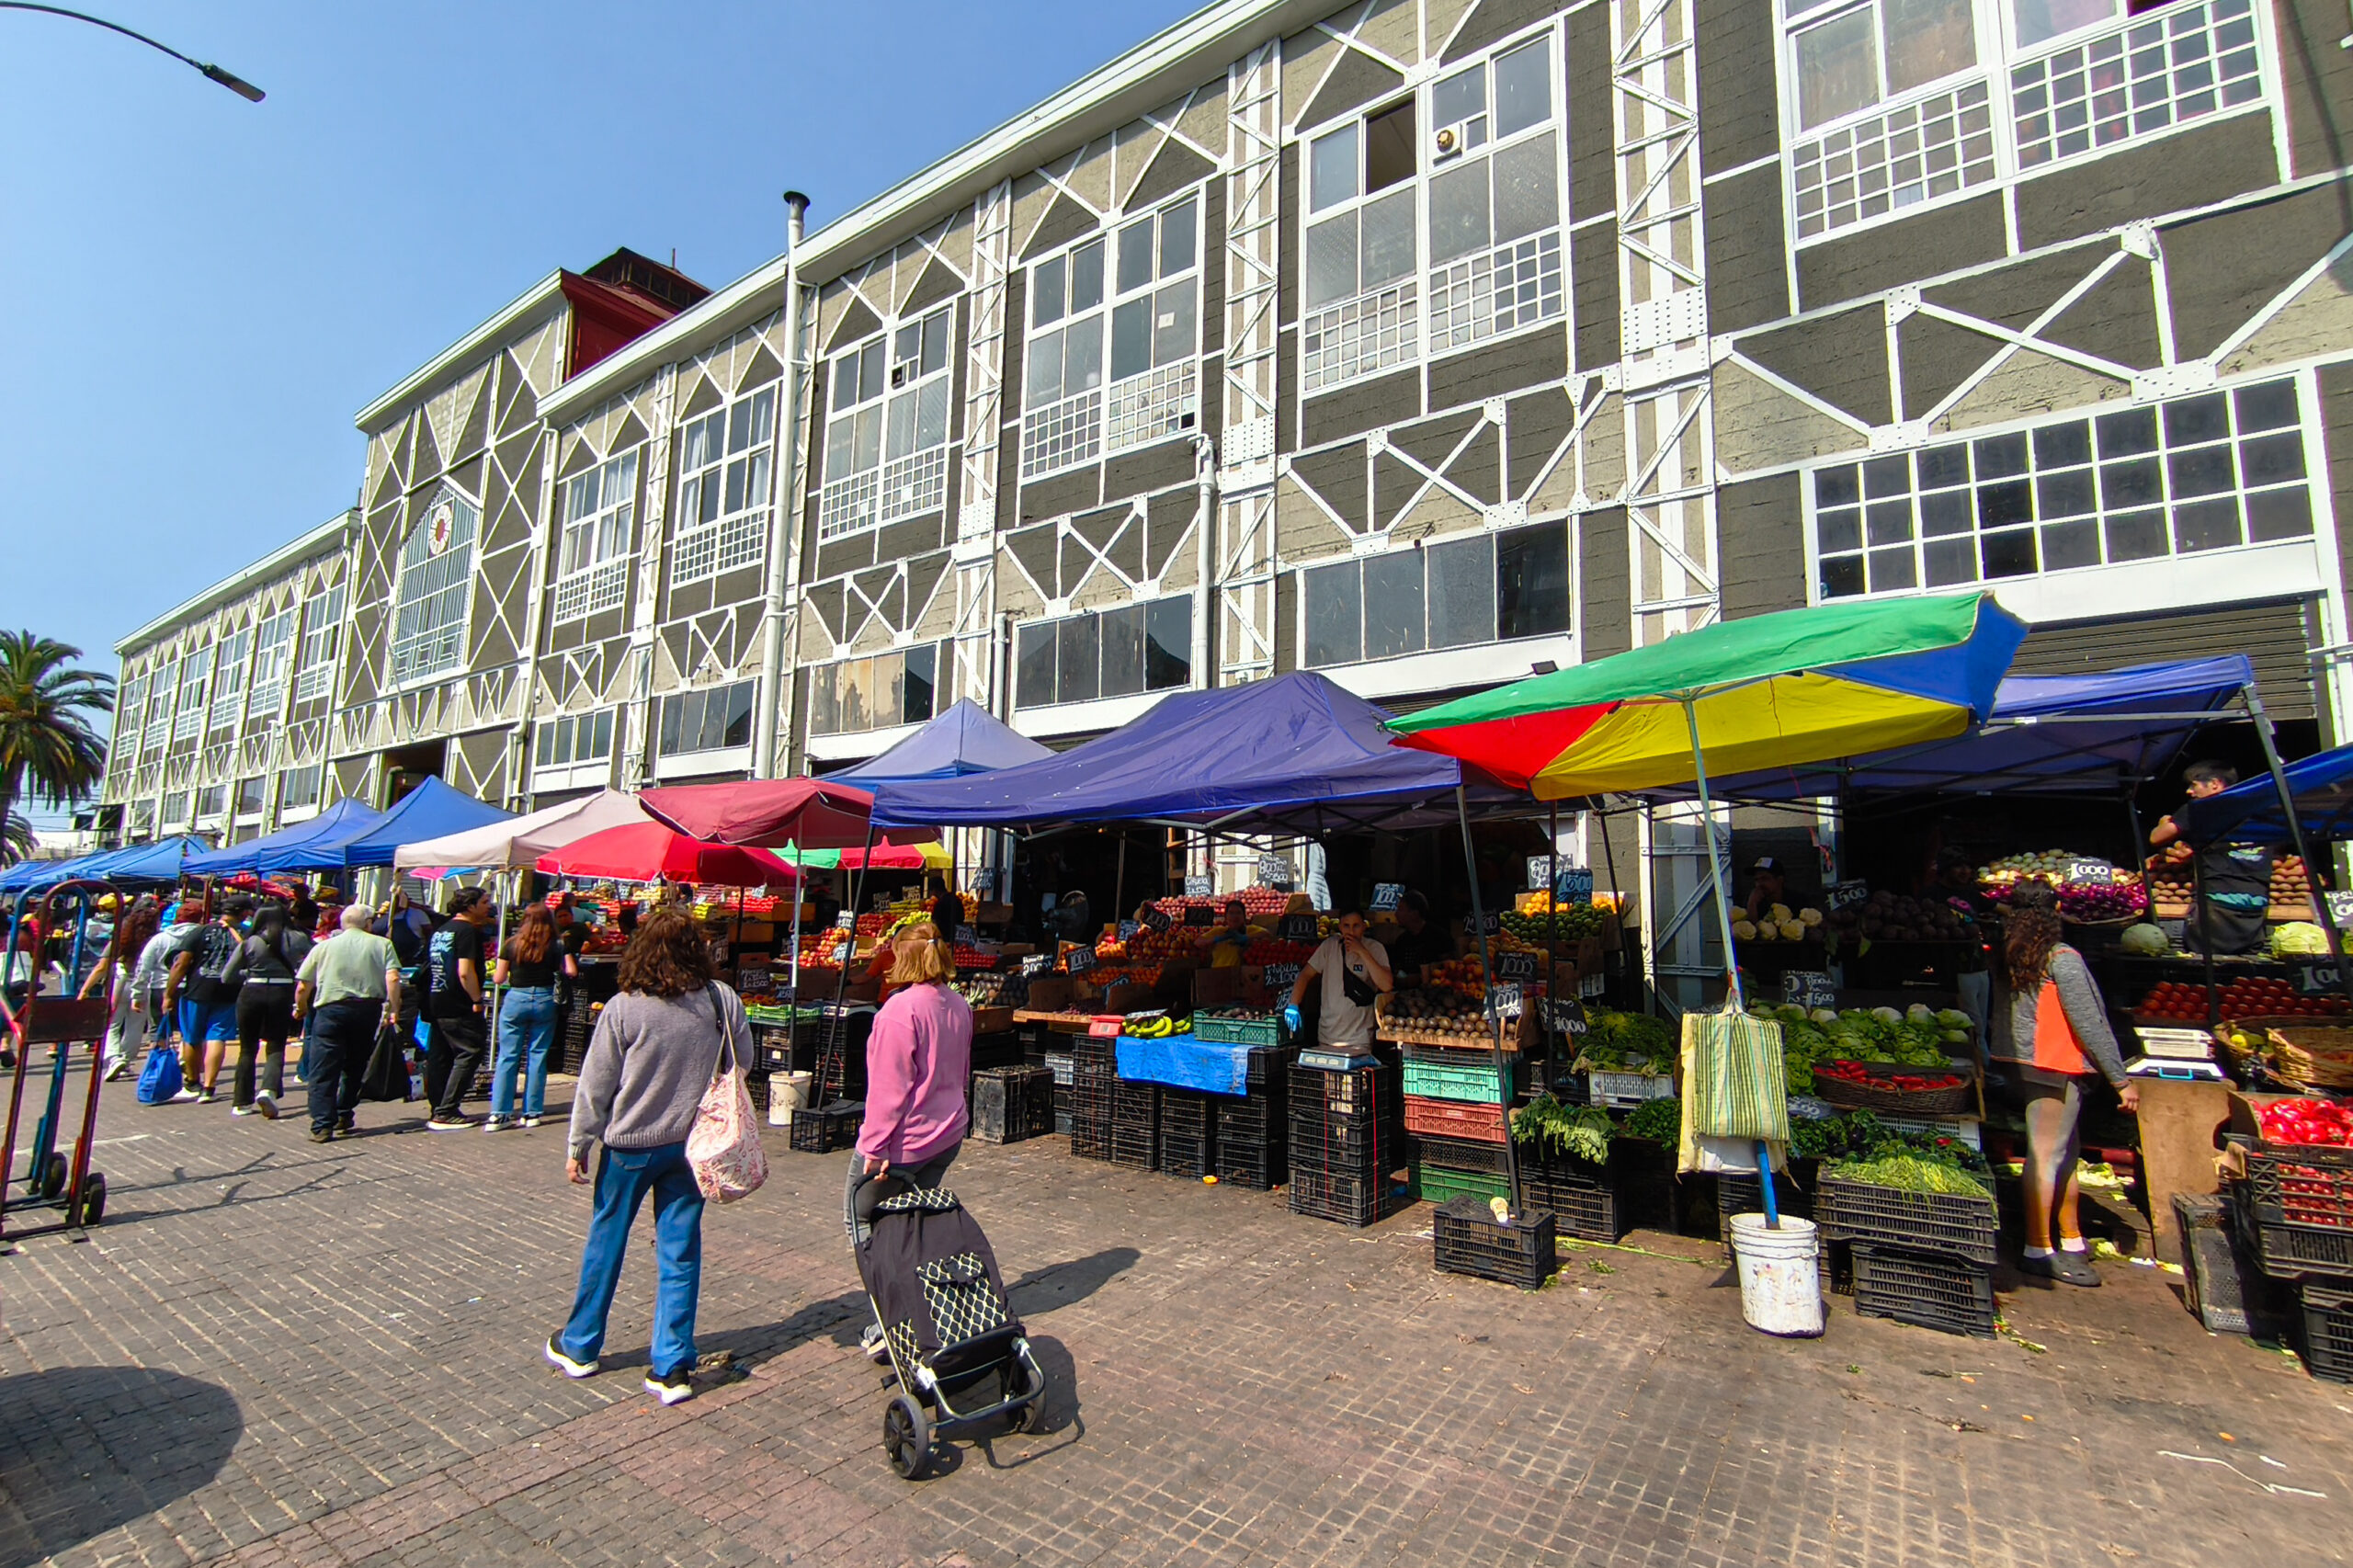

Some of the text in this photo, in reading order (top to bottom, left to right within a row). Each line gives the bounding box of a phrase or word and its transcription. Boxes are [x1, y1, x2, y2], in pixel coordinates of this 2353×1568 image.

[2066, 863, 2109, 881] 1000
[1558, 873, 1592, 892] 1500
[1070, 950, 1091, 970] 1000
